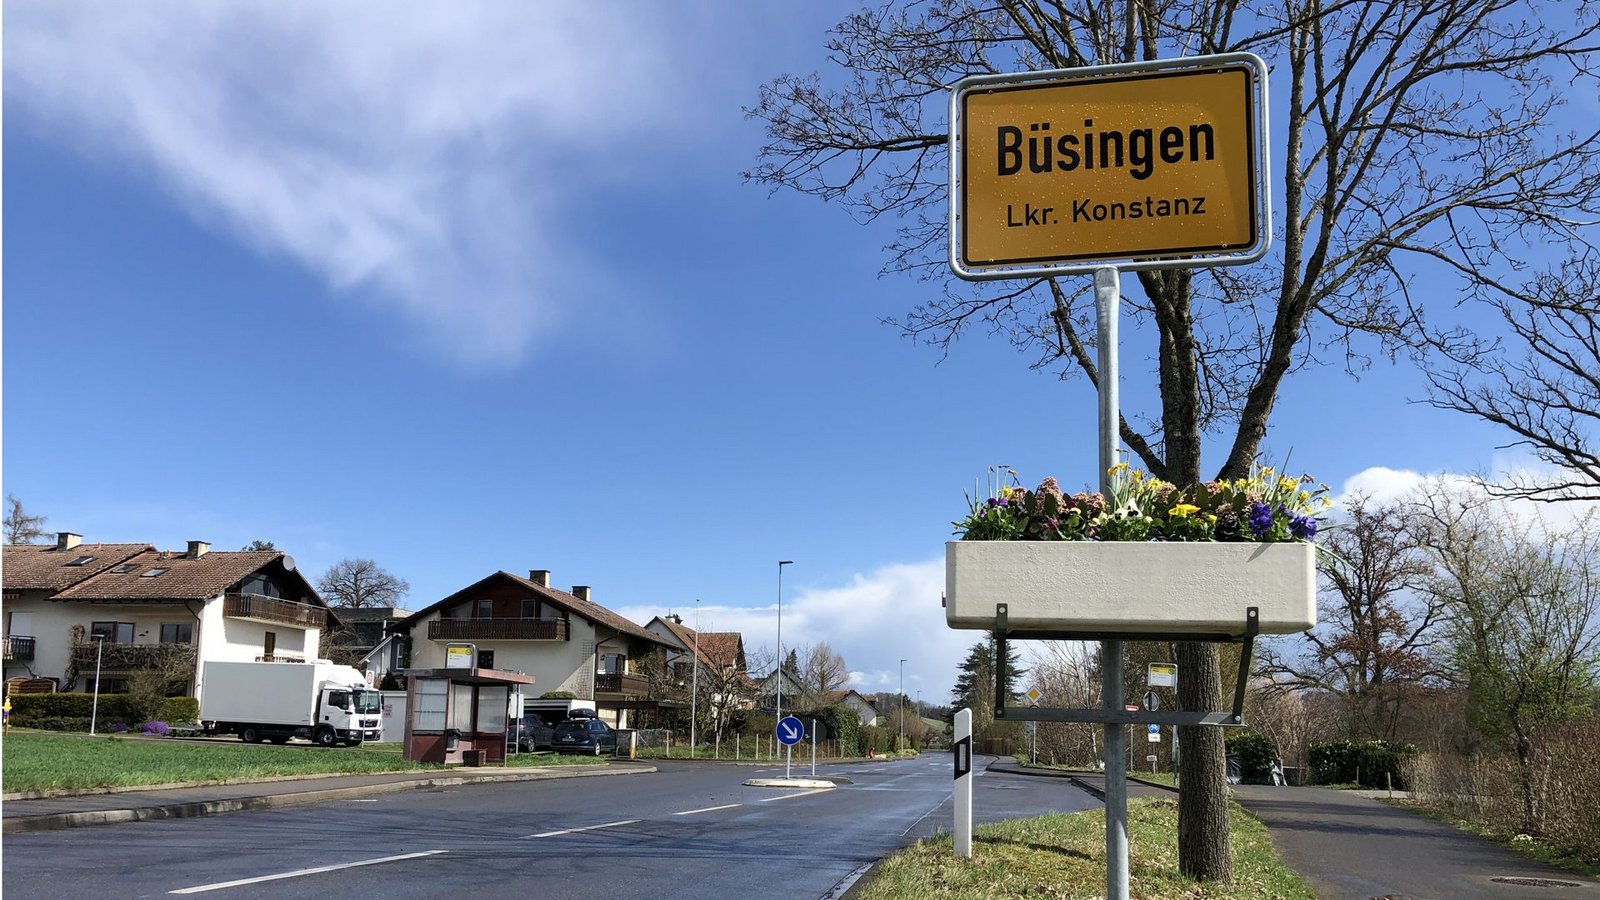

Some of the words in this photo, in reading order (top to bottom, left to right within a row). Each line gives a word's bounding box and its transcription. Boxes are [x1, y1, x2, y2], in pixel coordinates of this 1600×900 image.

[997, 118, 1215, 181] Büsingen
[1007, 203, 1058, 228] Lkr.
[1072, 196, 1207, 223] Konstanz
